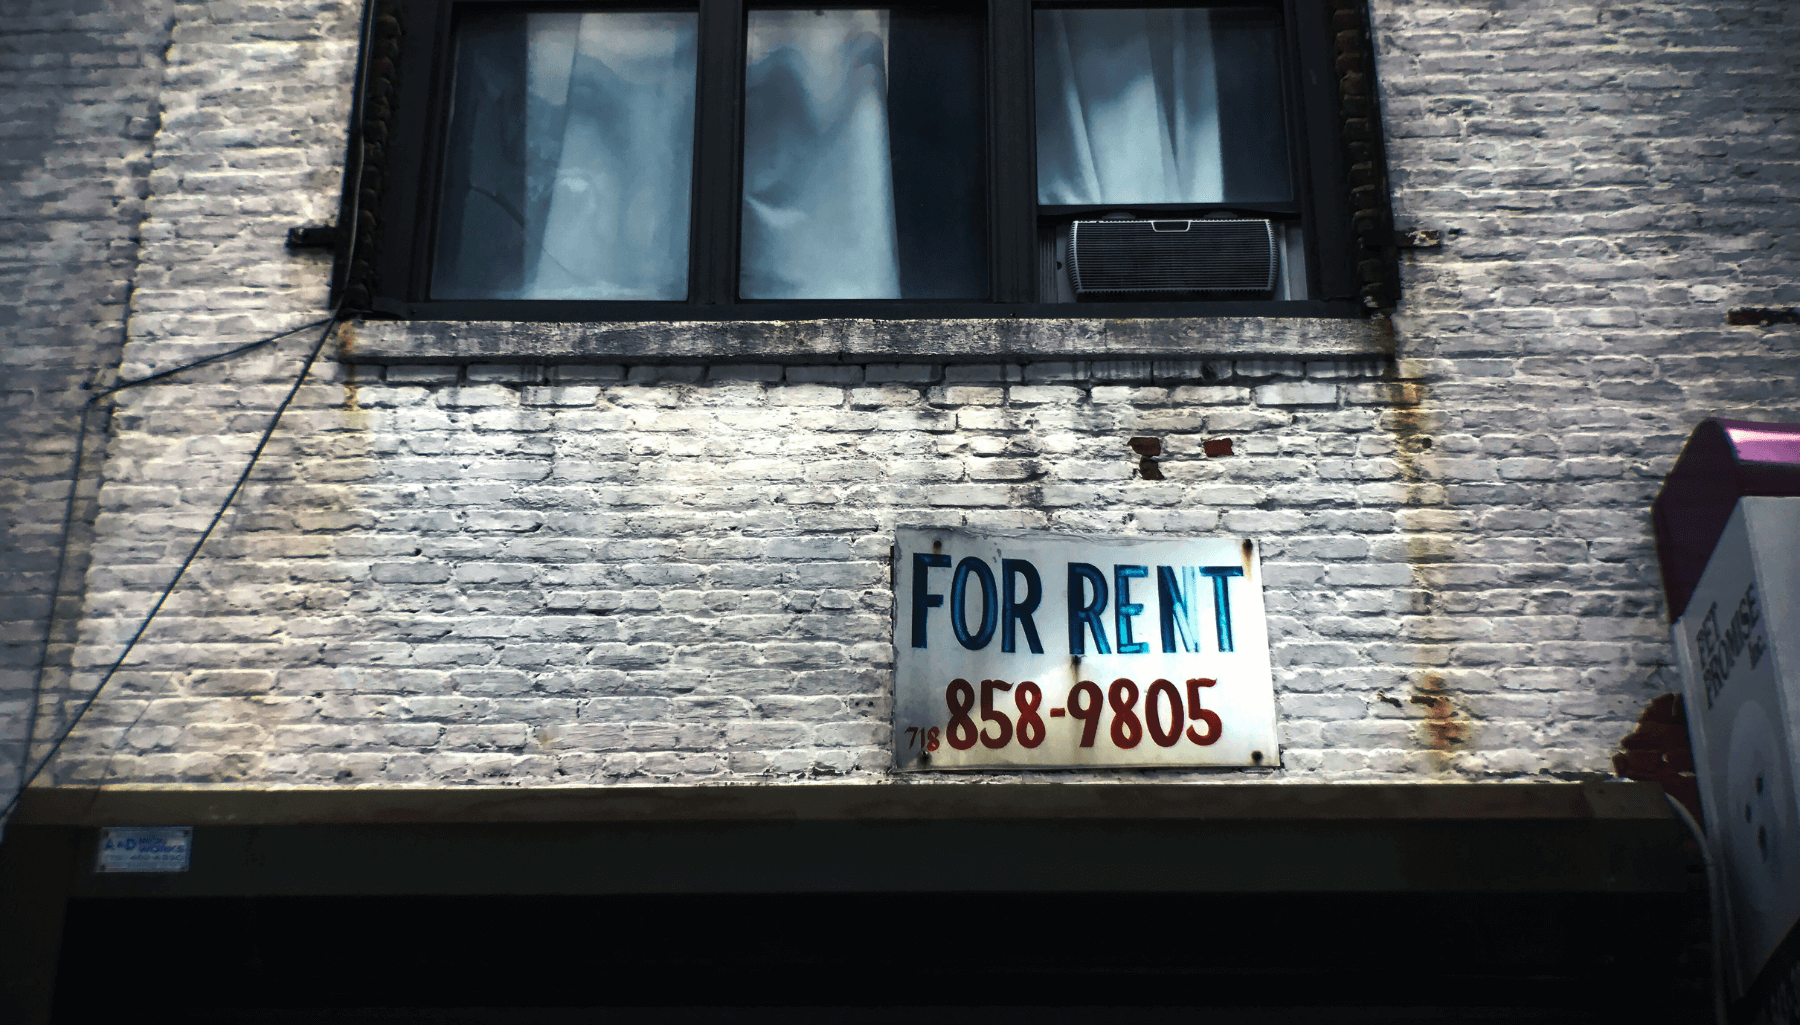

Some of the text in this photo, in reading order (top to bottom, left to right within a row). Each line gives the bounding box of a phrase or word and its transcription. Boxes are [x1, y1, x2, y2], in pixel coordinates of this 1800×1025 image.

[911, 552, 1244, 654] FOR RENT
[904, 678, 1223, 752] 718 858-9805
